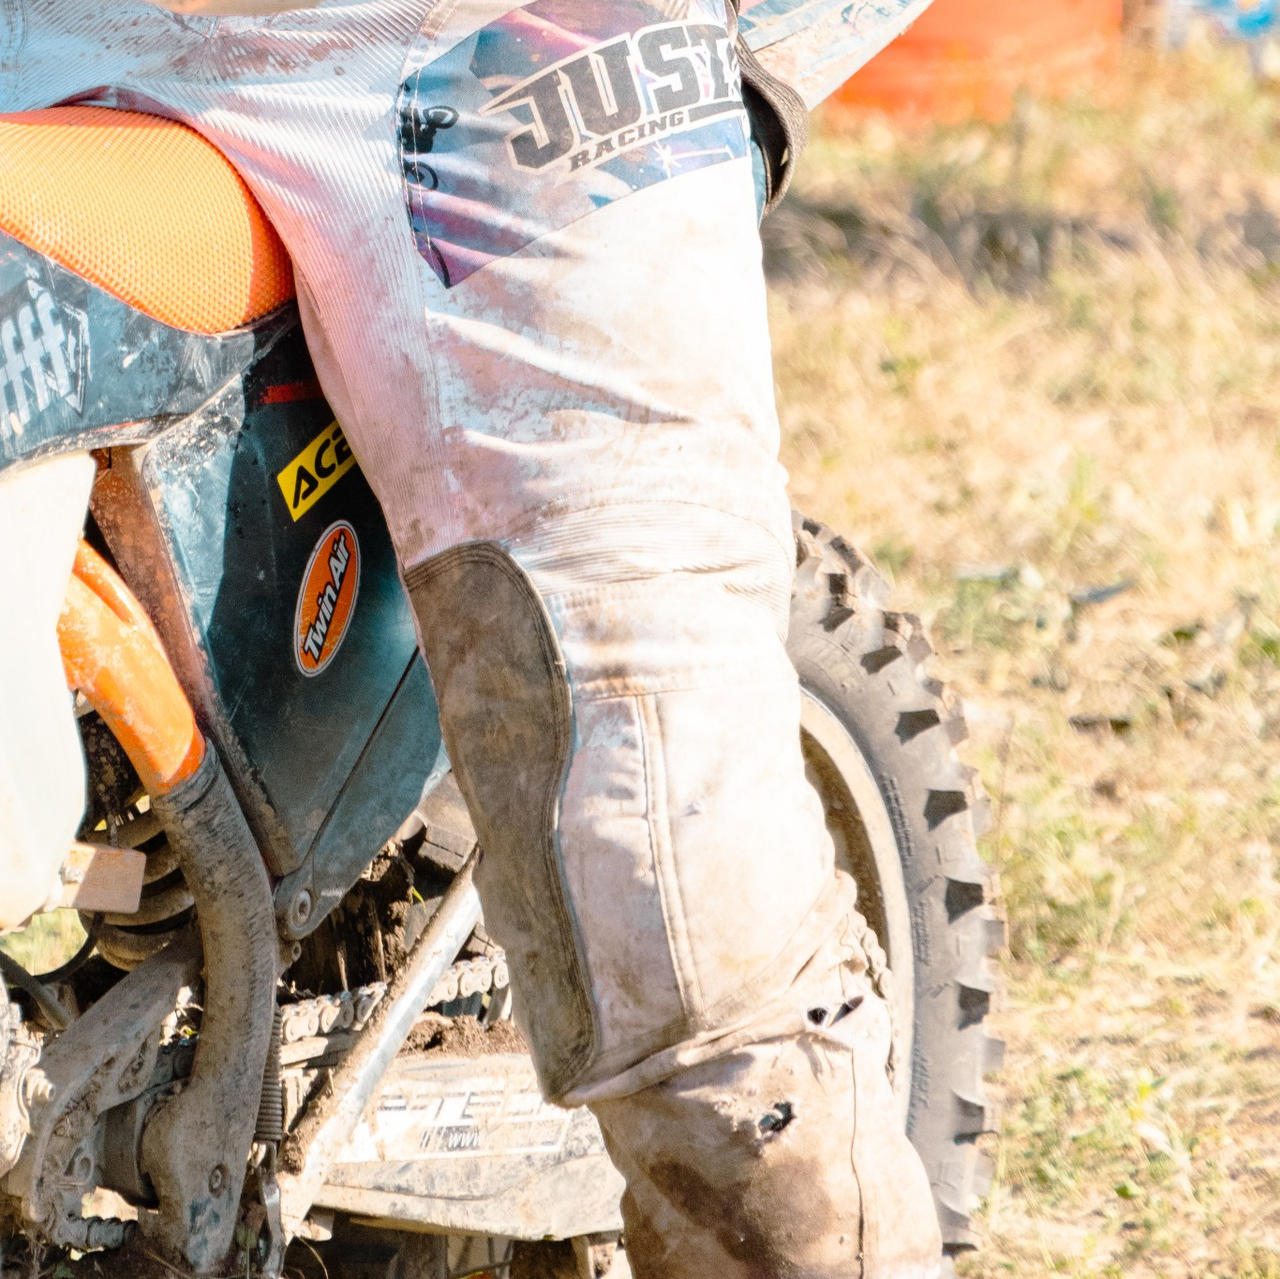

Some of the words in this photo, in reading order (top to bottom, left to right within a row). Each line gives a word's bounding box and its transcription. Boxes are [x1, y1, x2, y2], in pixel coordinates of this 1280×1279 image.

[570, 111, 684, 173] RACING
[304, 584, 337, 660] Twin
[329, 534, 351, 586] Air
